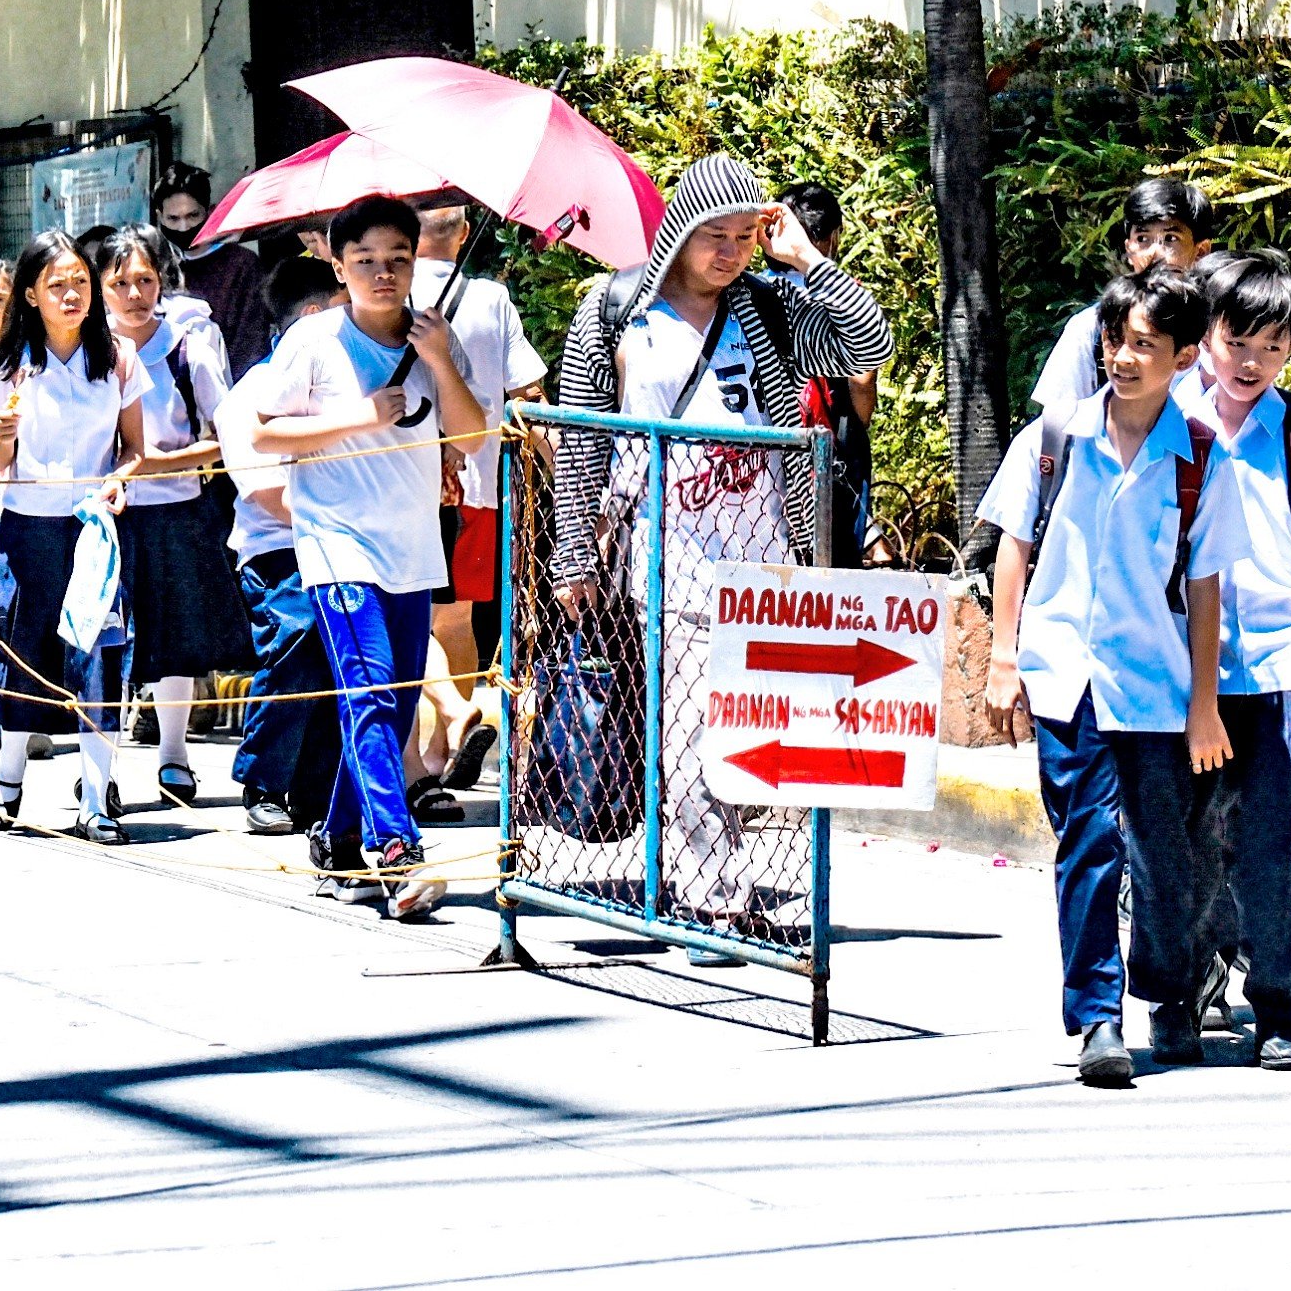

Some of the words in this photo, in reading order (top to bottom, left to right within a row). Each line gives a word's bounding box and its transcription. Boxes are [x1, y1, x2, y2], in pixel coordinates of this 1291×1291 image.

[717, 586, 834, 631] DAANAN
[835, 614, 877, 632] MGA
[840, 595, 864, 612] NG
[884, 595, 939, 635] TAO
[707, 690, 790, 731] DAANAN
[792, 706, 807, 719] NG
[809, 706, 831, 719] MGA
[832, 696, 938, 738] SASAKYAN
